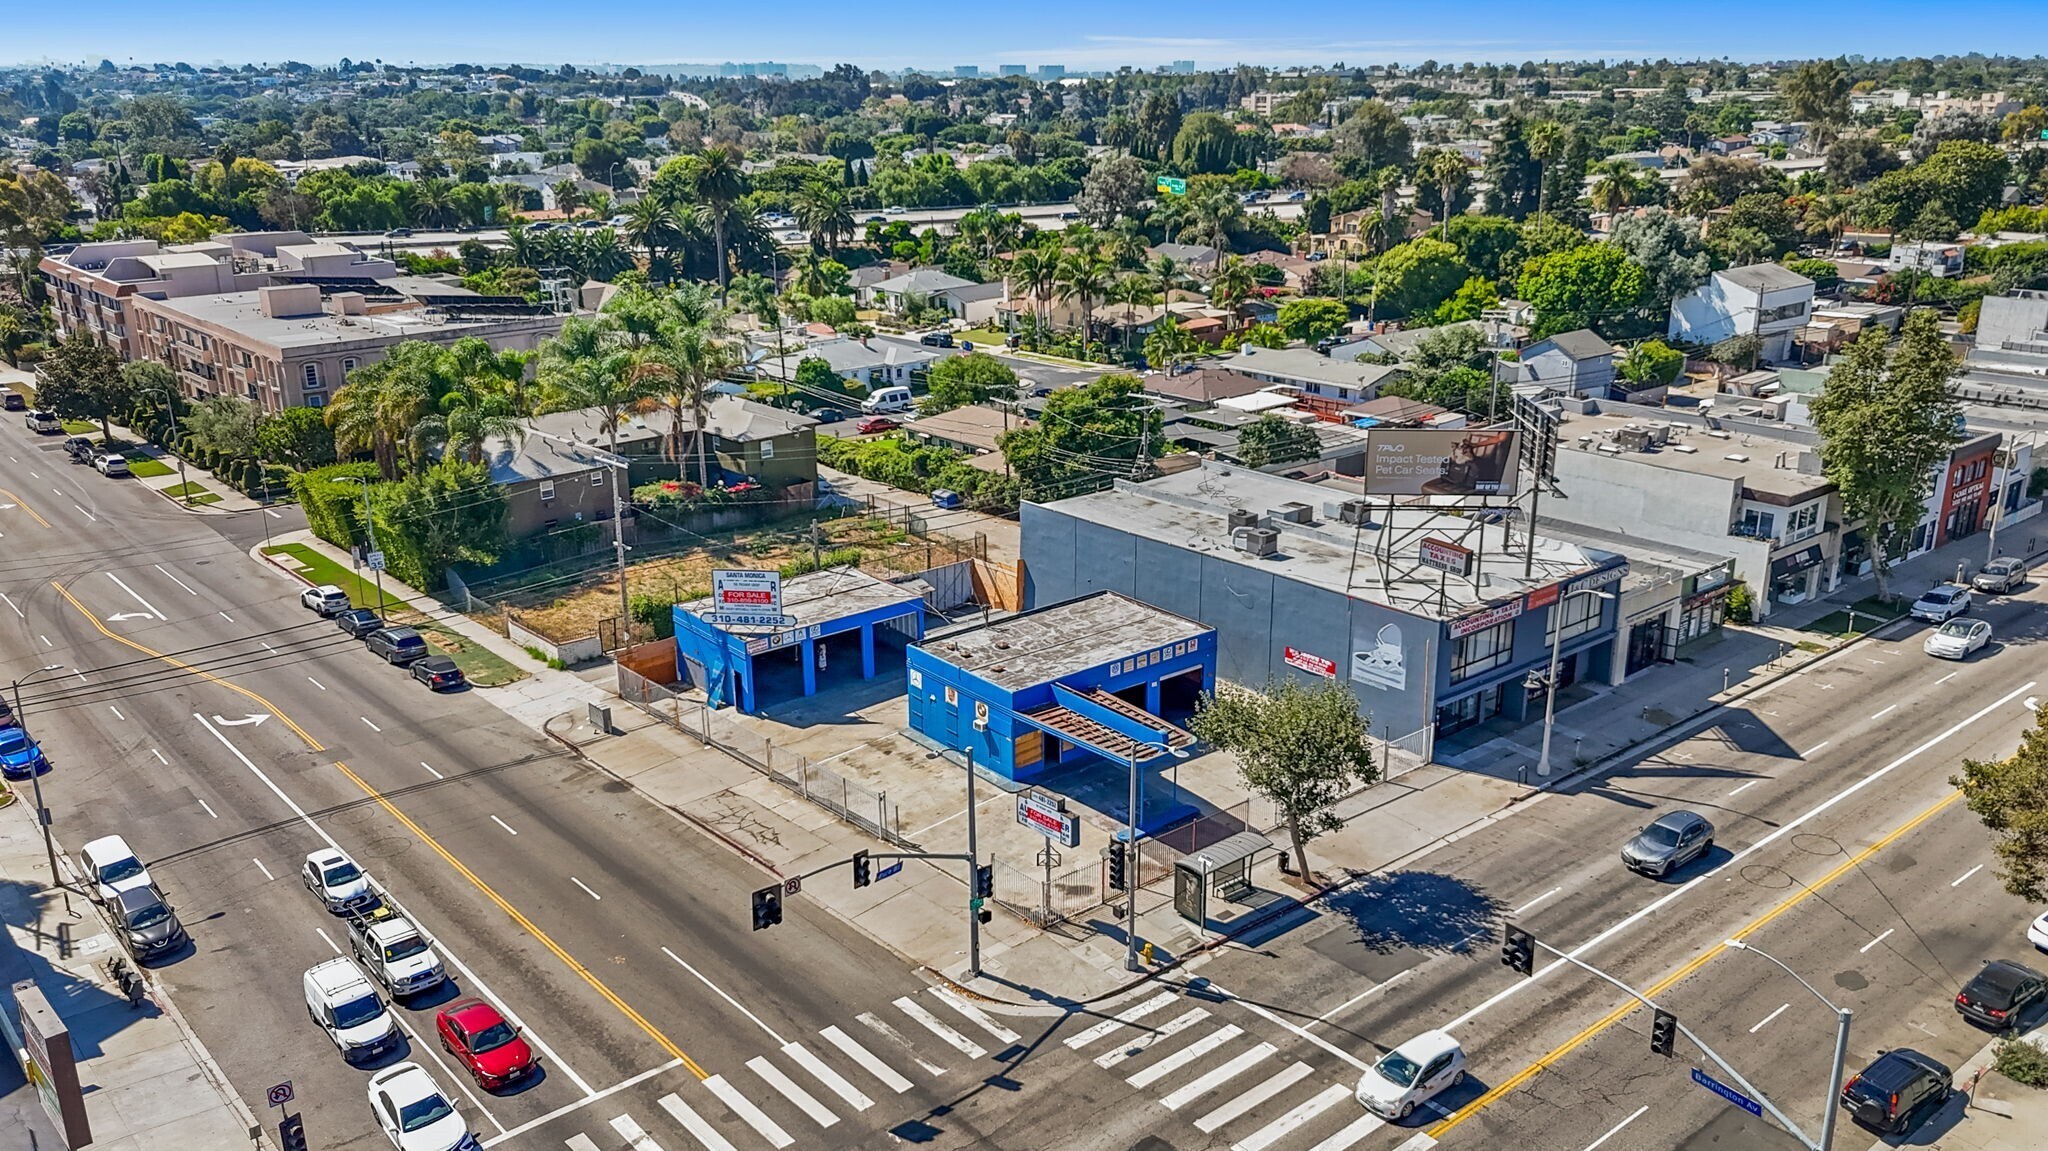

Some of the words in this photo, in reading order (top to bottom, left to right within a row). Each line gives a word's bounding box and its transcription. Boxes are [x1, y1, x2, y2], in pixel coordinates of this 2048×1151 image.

[1376, 454, 1413, 464] Impact
[1416, 454, 1450, 464] Tested
[1376, 466, 1392, 474] Pet
[1394, 466, 1412, 474] Car
[1416, 466, 1448, 474] Seats.
[1422, 542, 1464, 560] ACCOUNTING
[1429, 552, 1456, 564] TAXES
[371, 561, 384, 569] 35
[1454, 612, 1494, 630] ACCOUNTING
[1502, 602, 1520, 613] TAXES
[1695, 1072, 1744, 1105] Barrington
[1746, 1102, 1758, 1112] Av
